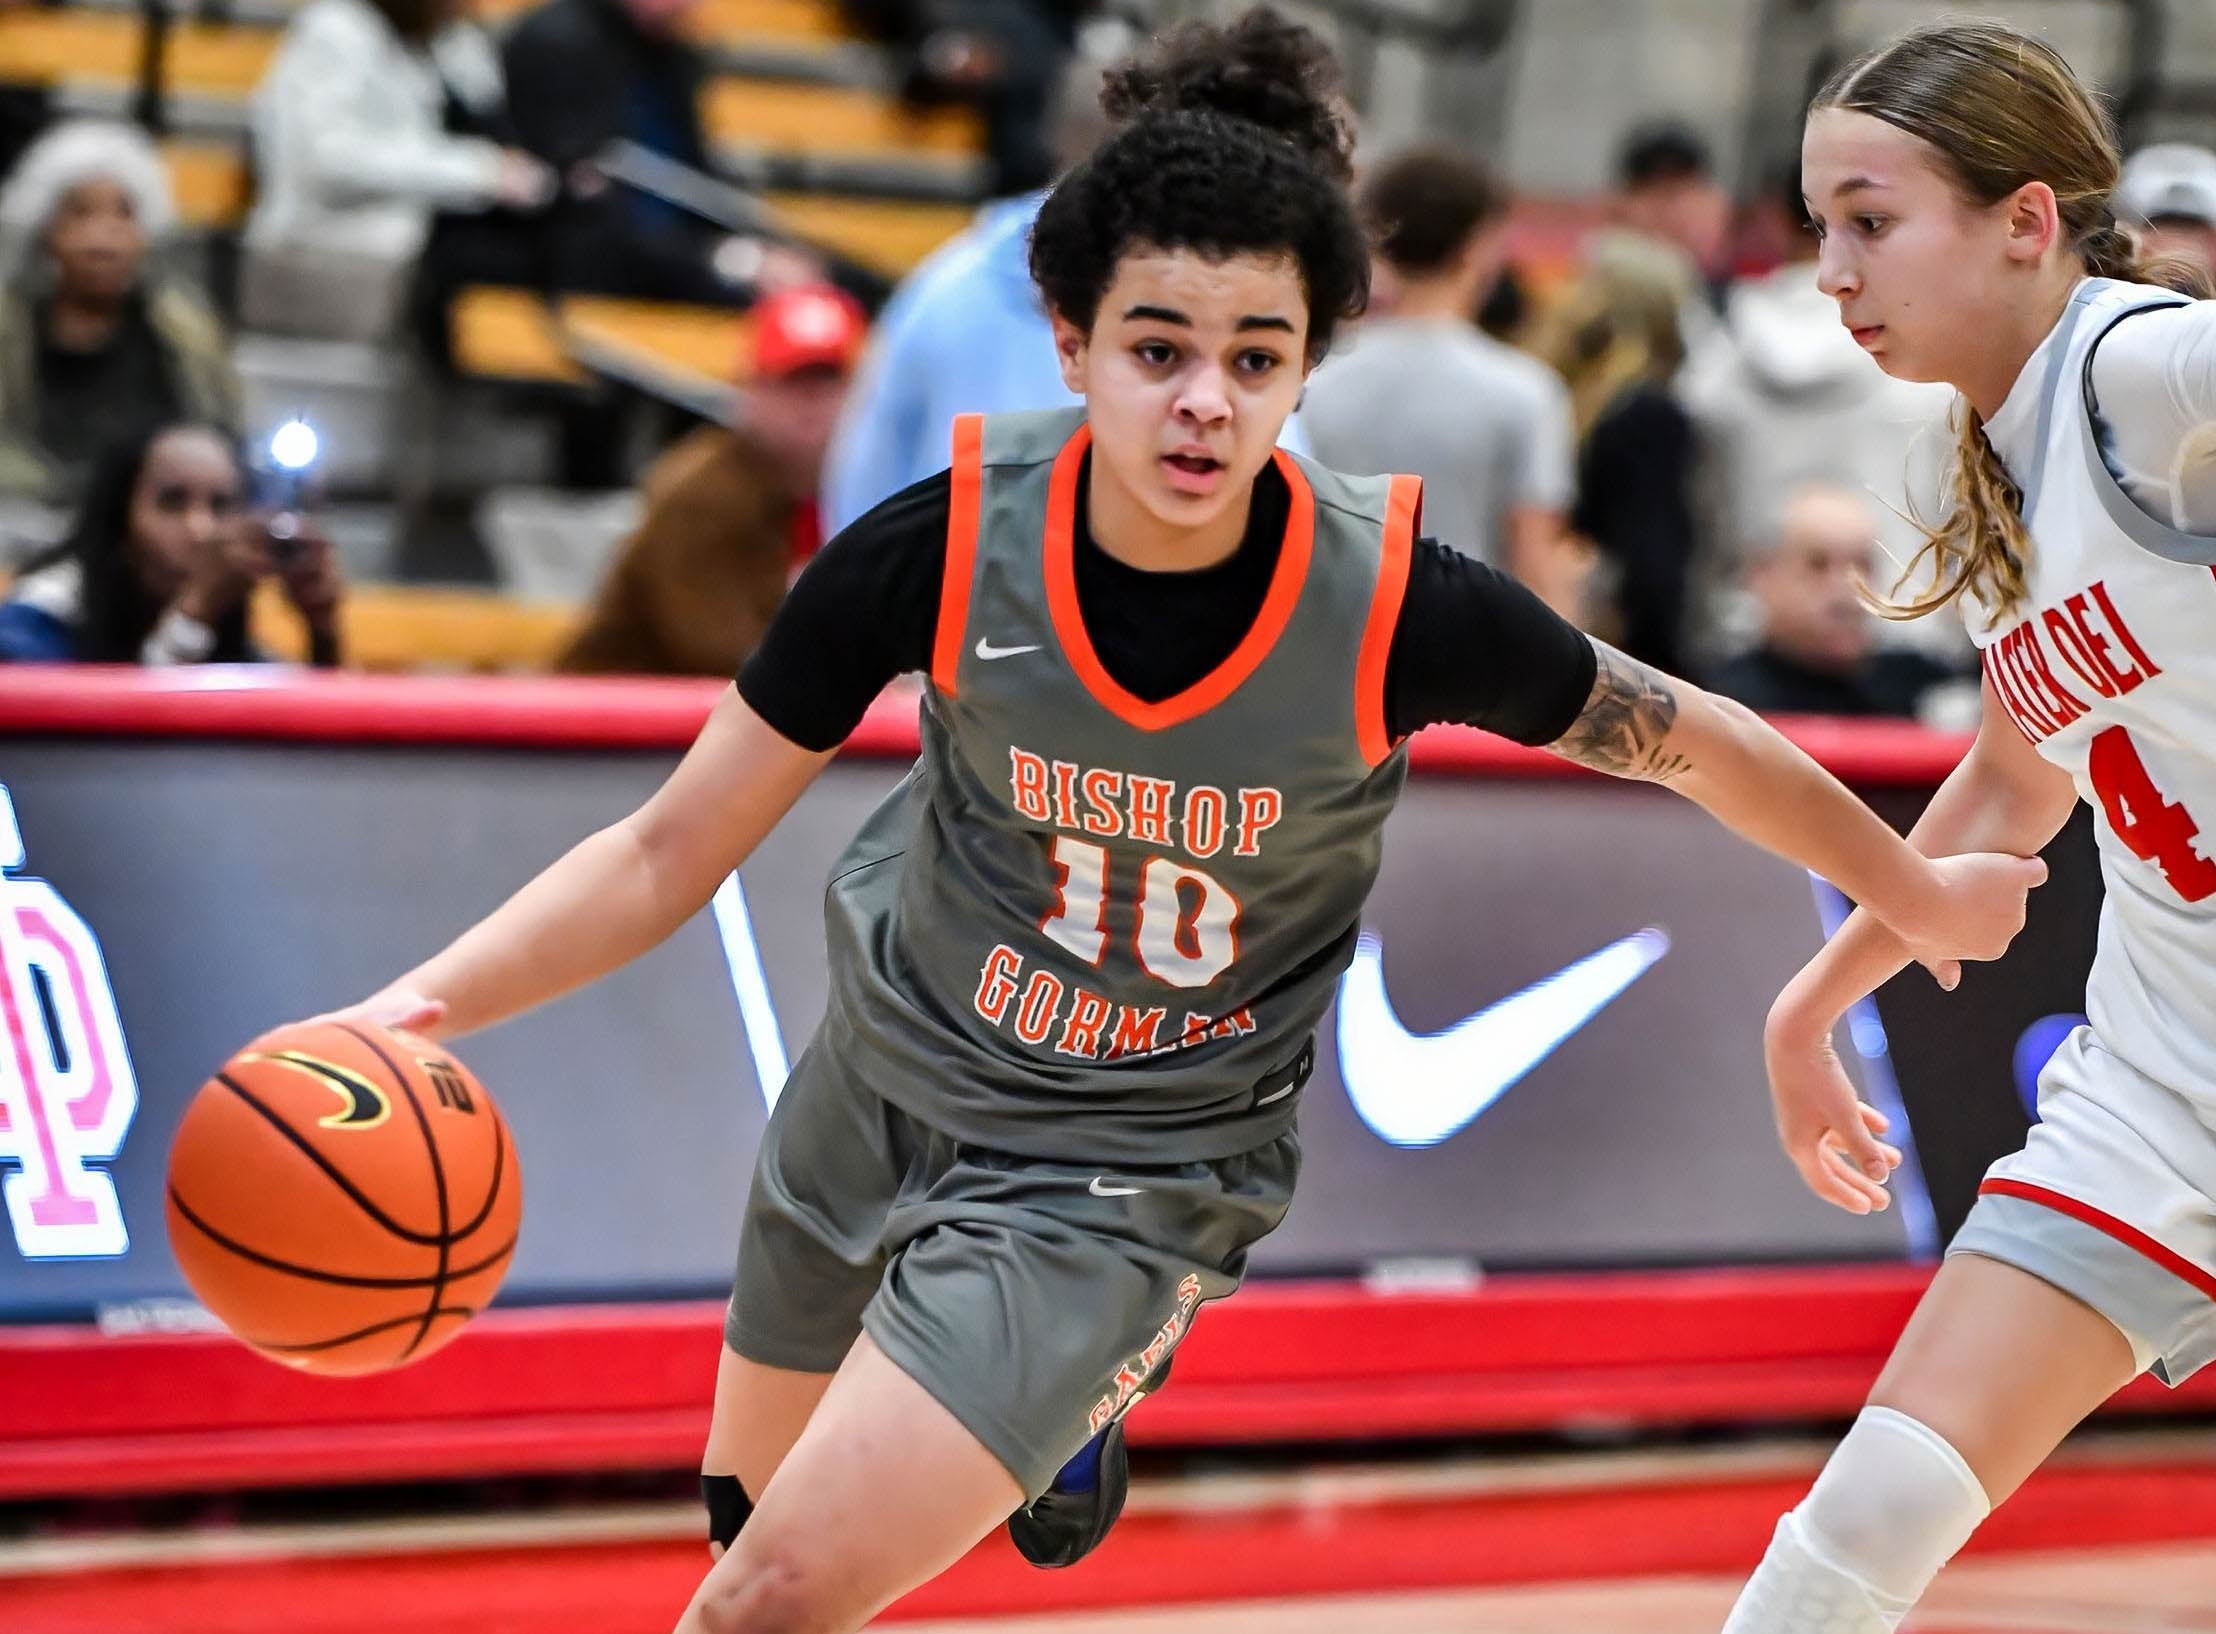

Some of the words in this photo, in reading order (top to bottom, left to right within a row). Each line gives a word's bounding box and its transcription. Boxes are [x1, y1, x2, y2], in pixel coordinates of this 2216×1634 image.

[1979, 620, 2093, 746] ATER
[2041, 580, 2164, 699] DEI
[1008, 745, 1283, 858] BISHOP
[2088, 724, 2216, 904] 4
[1037, 834, 1243, 989] 10
